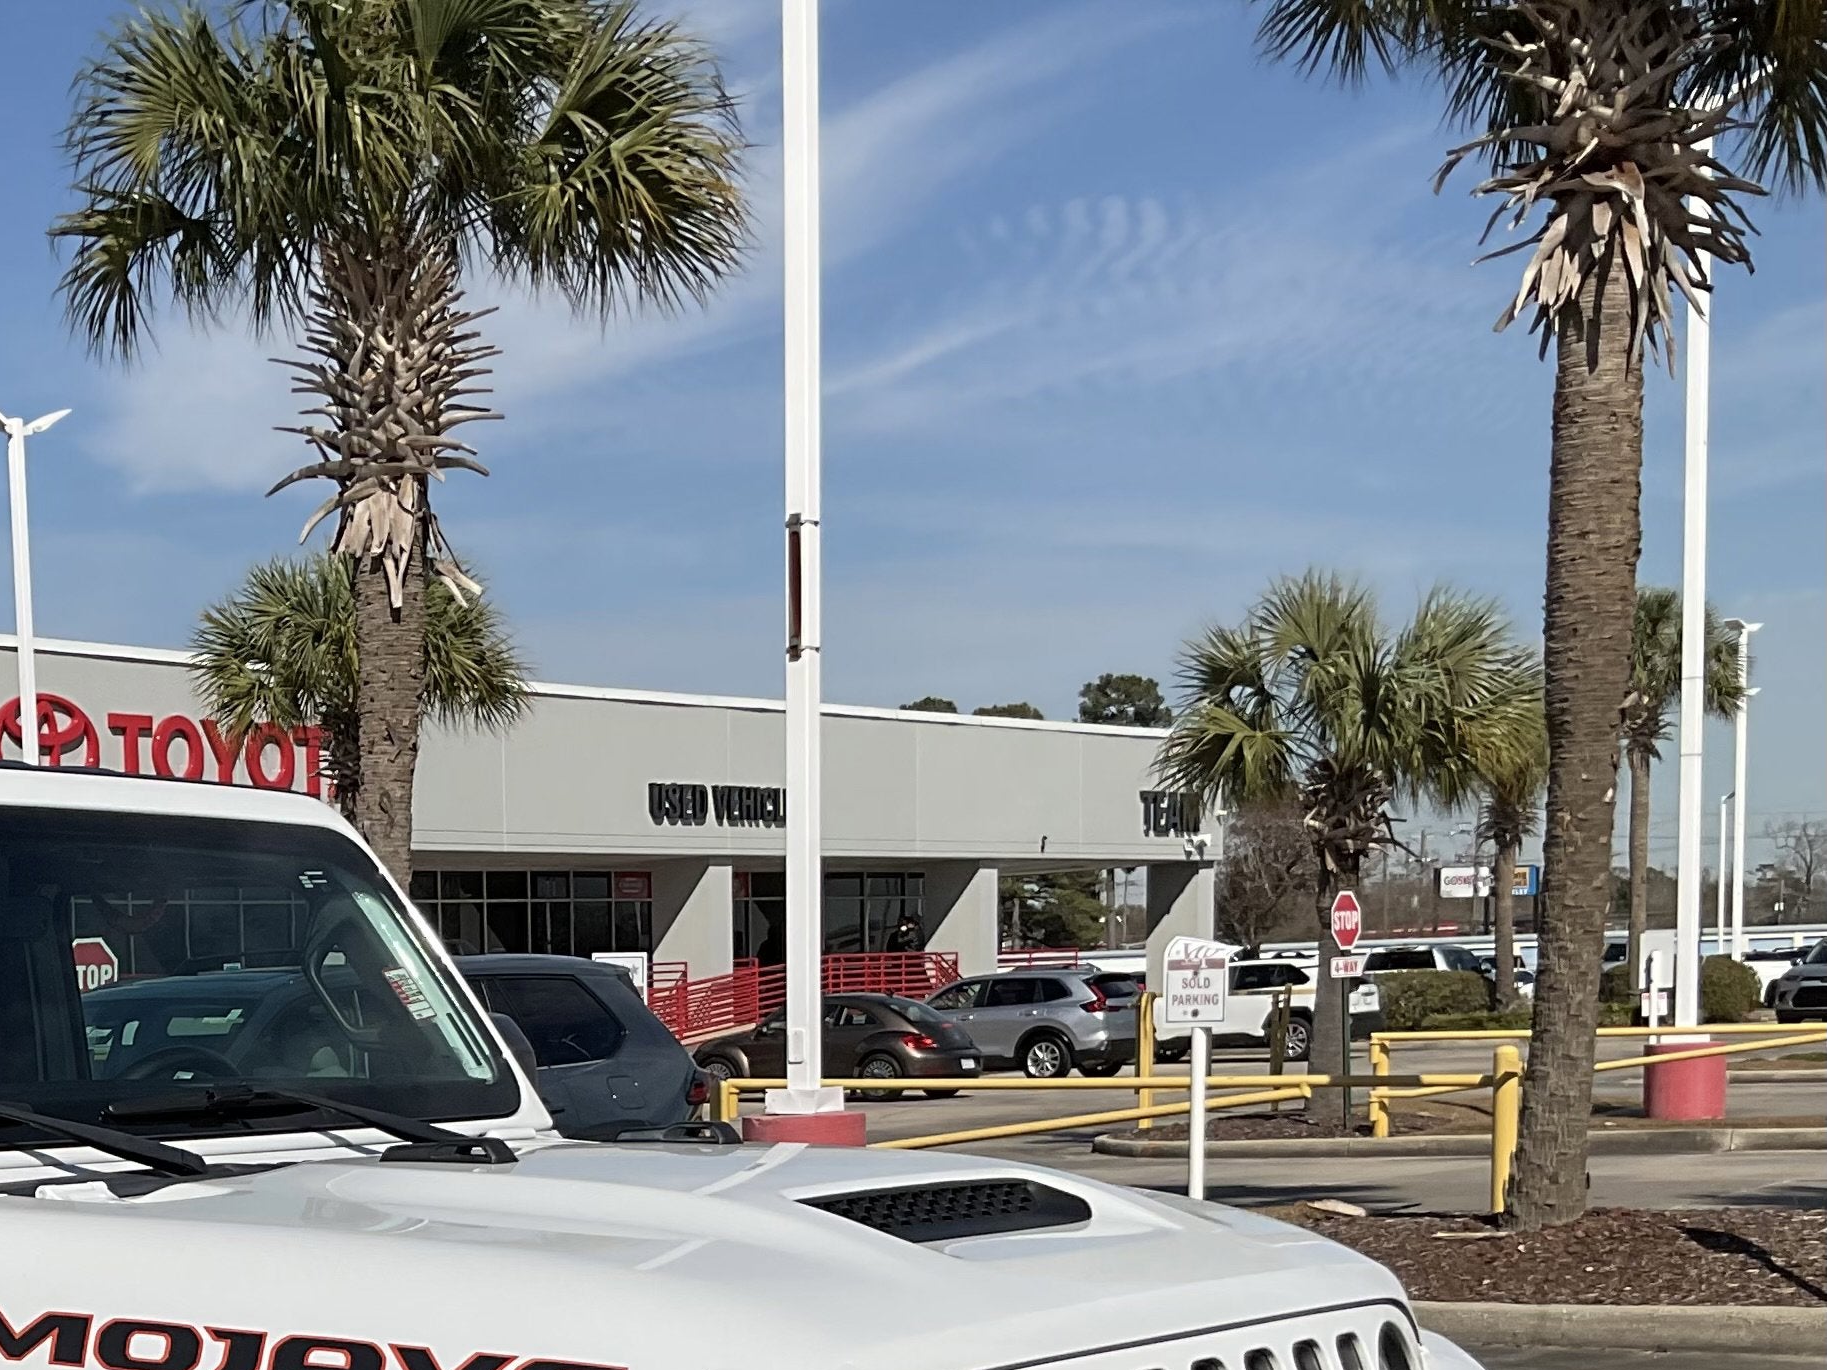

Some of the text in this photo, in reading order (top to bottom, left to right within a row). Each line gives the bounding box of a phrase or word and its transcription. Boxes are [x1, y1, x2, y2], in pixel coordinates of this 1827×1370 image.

[107, 713, 334, 798] TOYOT
[648, 783, 787, 828] USED VEHICL
[1334, 910, 1359, 931] STOP
[76, 964, 113, 990] TOP
[1334, 960, 1359, 974] 4-WAY
[1181, 976, 1211, 989] SOLD
[1171, 993, 1220, 1007] PARKING
